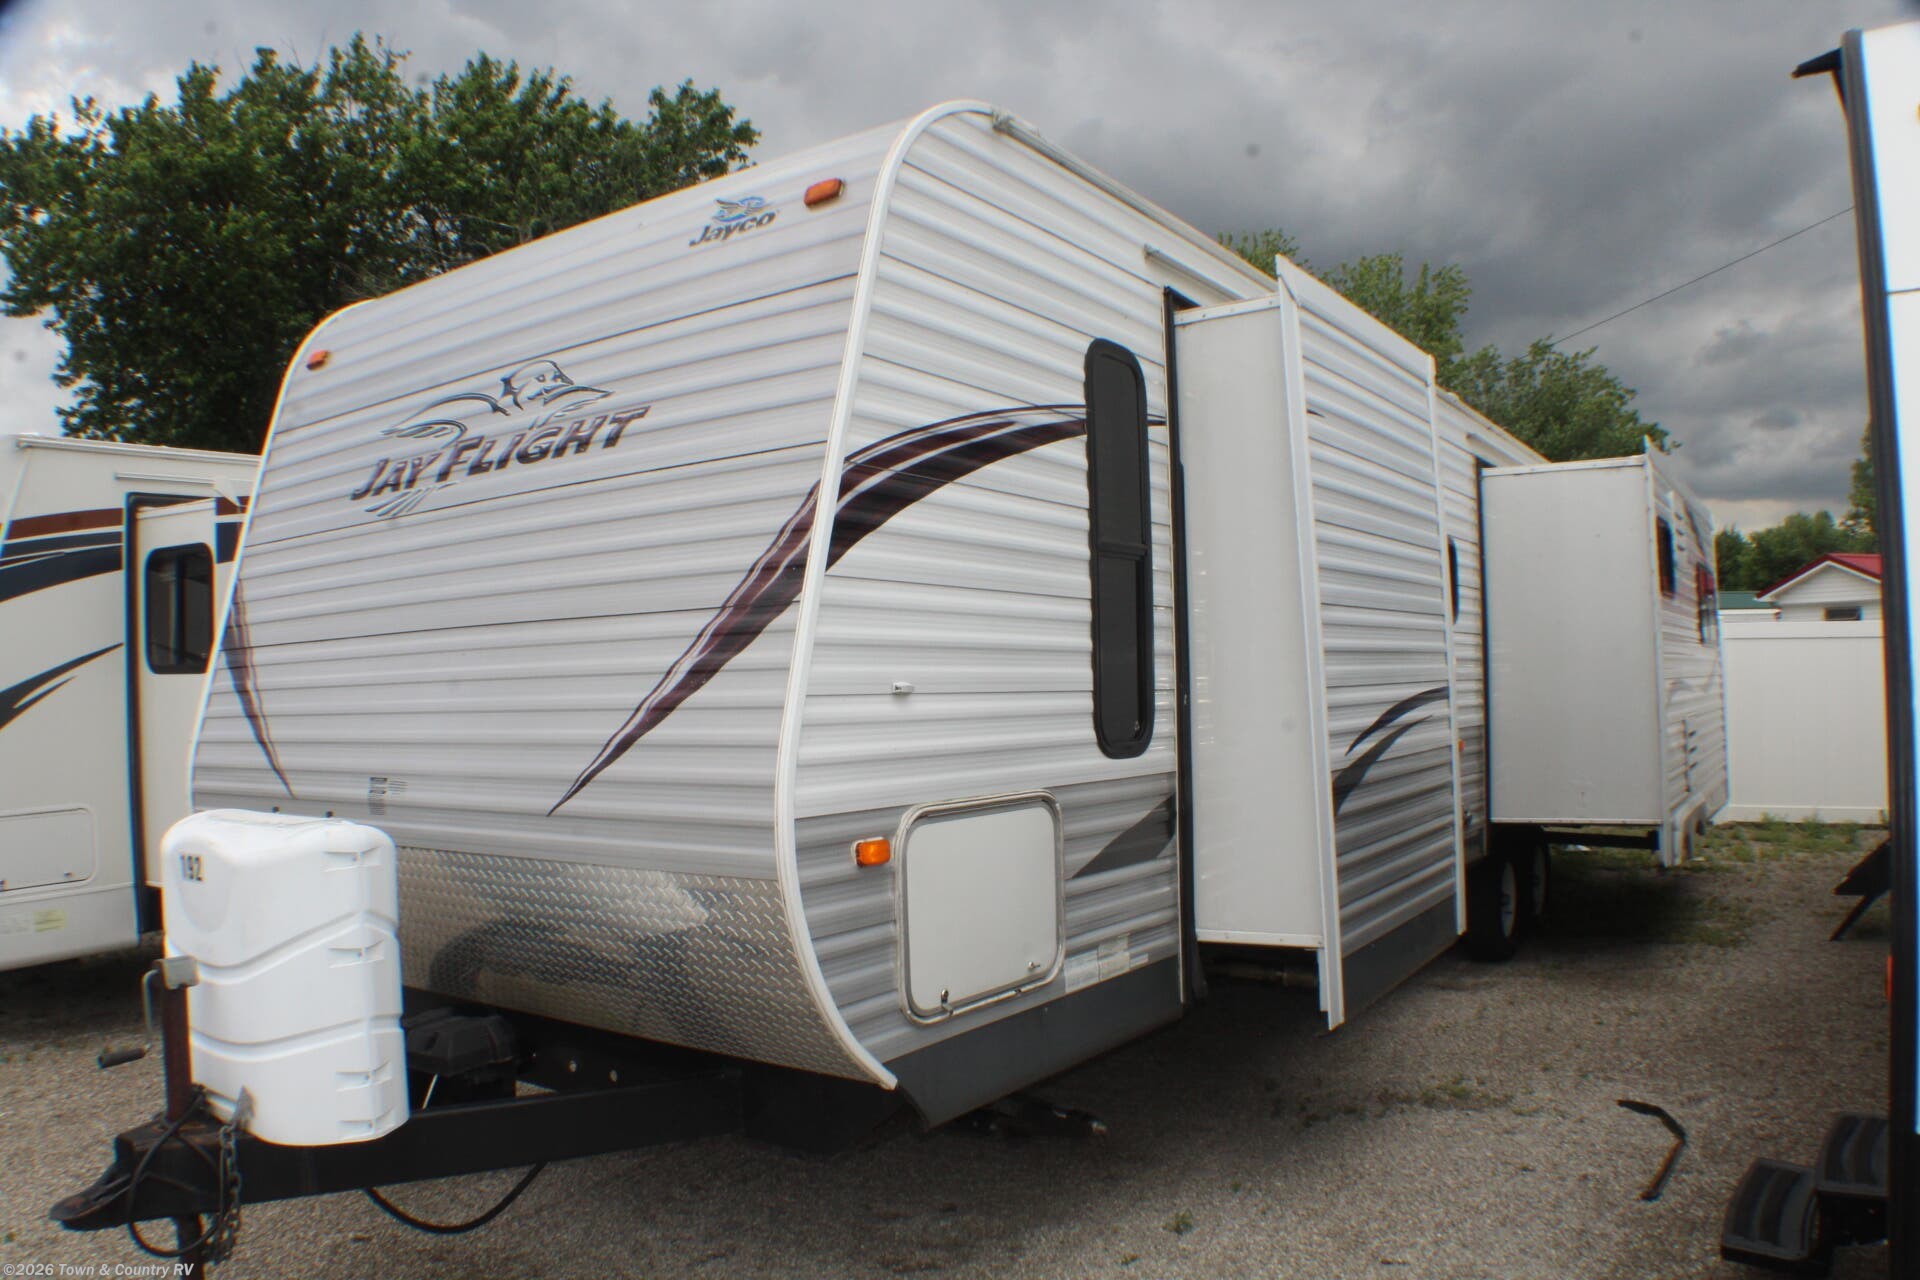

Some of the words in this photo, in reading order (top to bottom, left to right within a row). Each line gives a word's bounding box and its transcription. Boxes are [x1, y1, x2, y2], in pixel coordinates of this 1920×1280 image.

[689, 211, 777, 247] Jayco
[350, 457, 443, 501] JAY
[435, 405, 650, 483] FLIGHT
